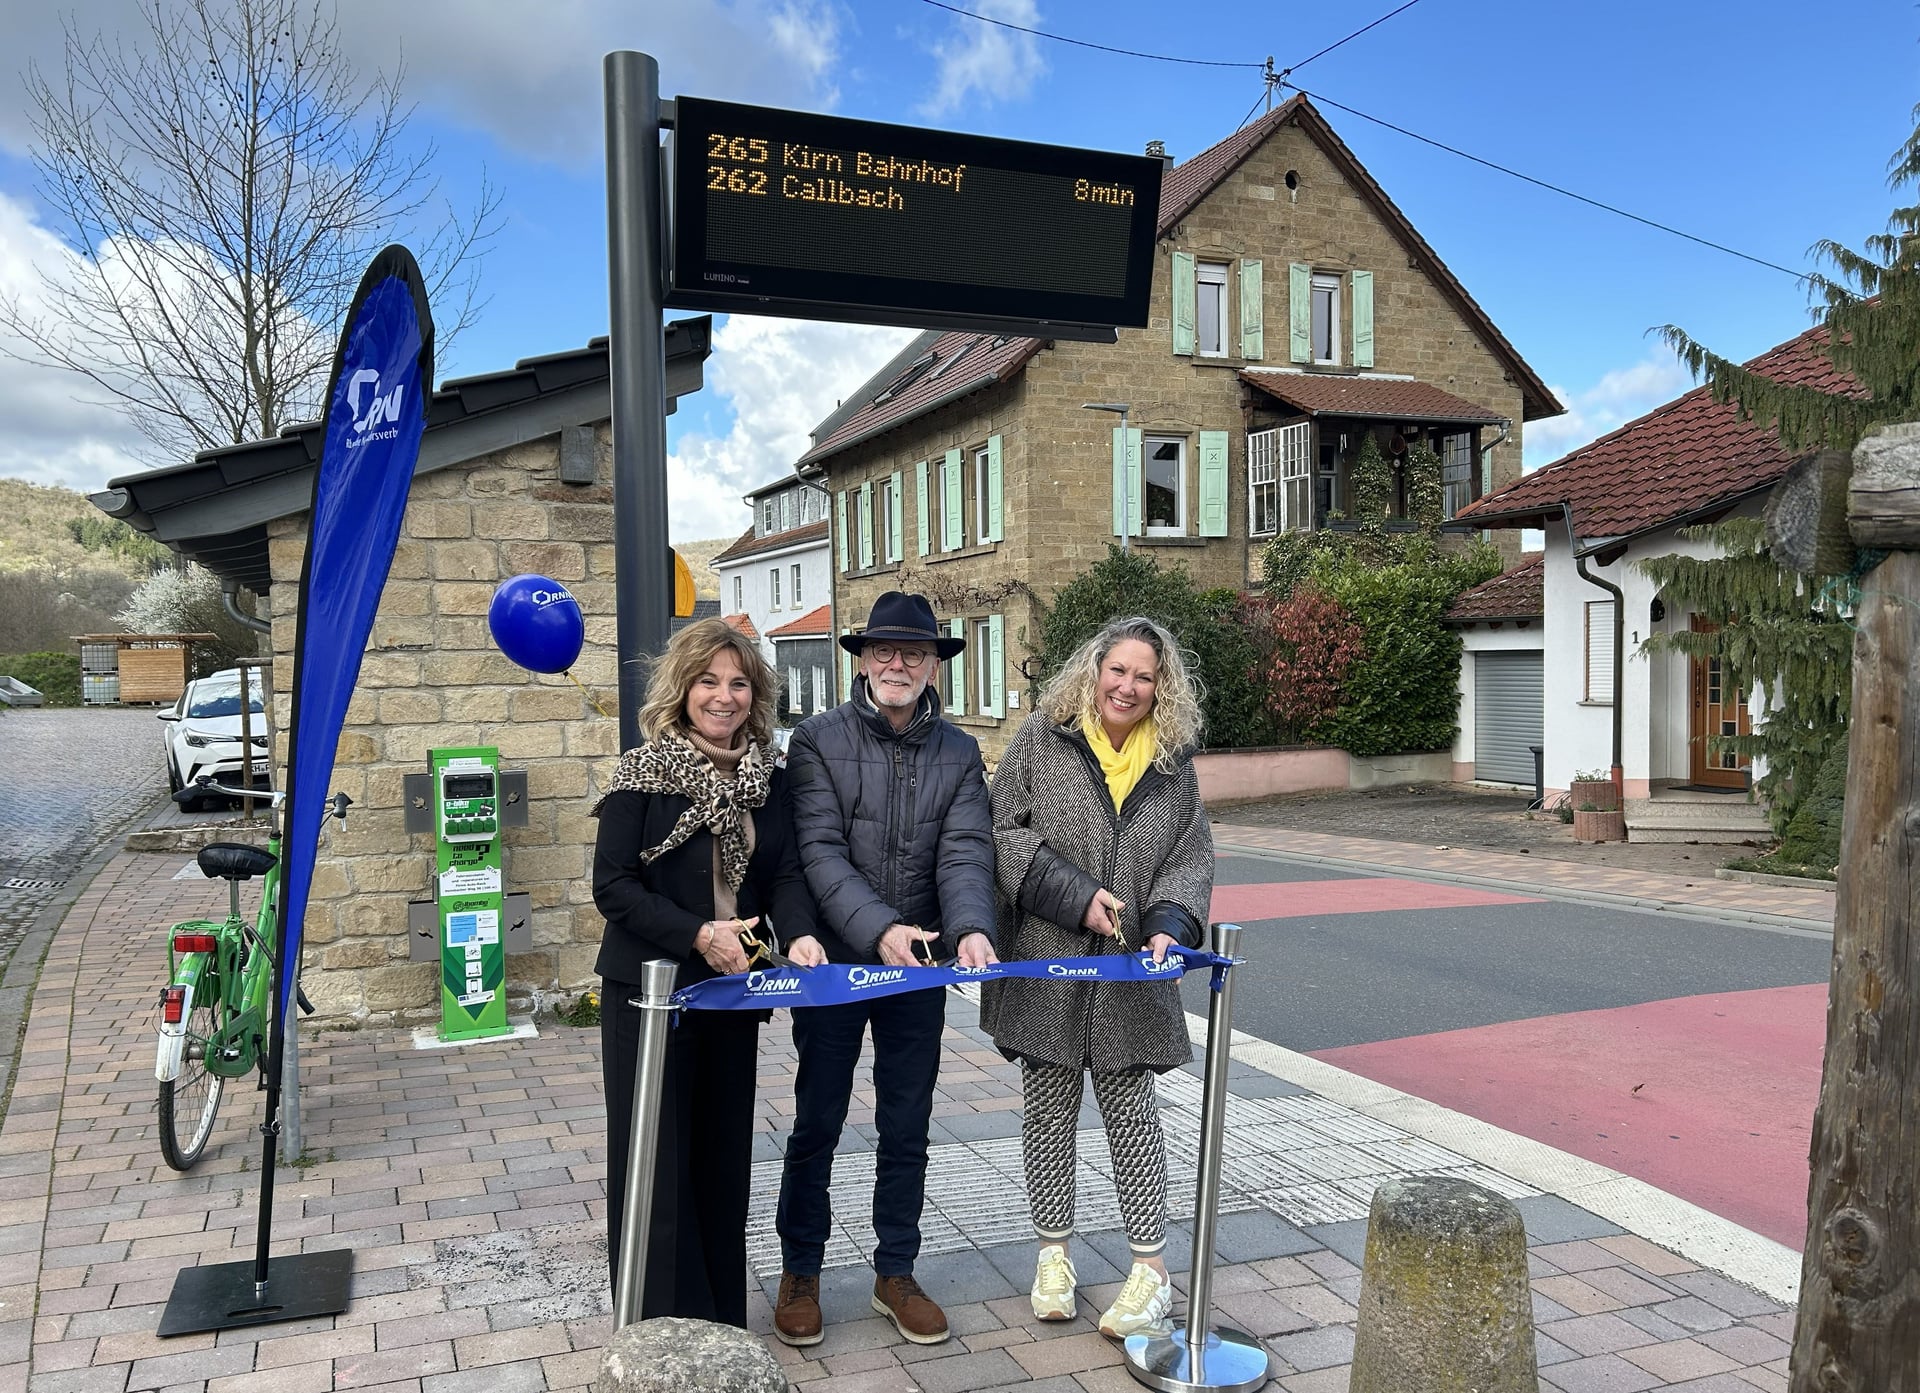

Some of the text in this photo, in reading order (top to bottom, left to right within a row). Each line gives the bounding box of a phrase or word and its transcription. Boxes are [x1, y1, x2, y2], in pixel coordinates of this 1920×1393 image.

[706, 165, 904, 210] 262 Callbach
[707, 133, 1134, 206] 265 Kirn Bahnhof 8min
[1631, 630, 1640, 644] 1
